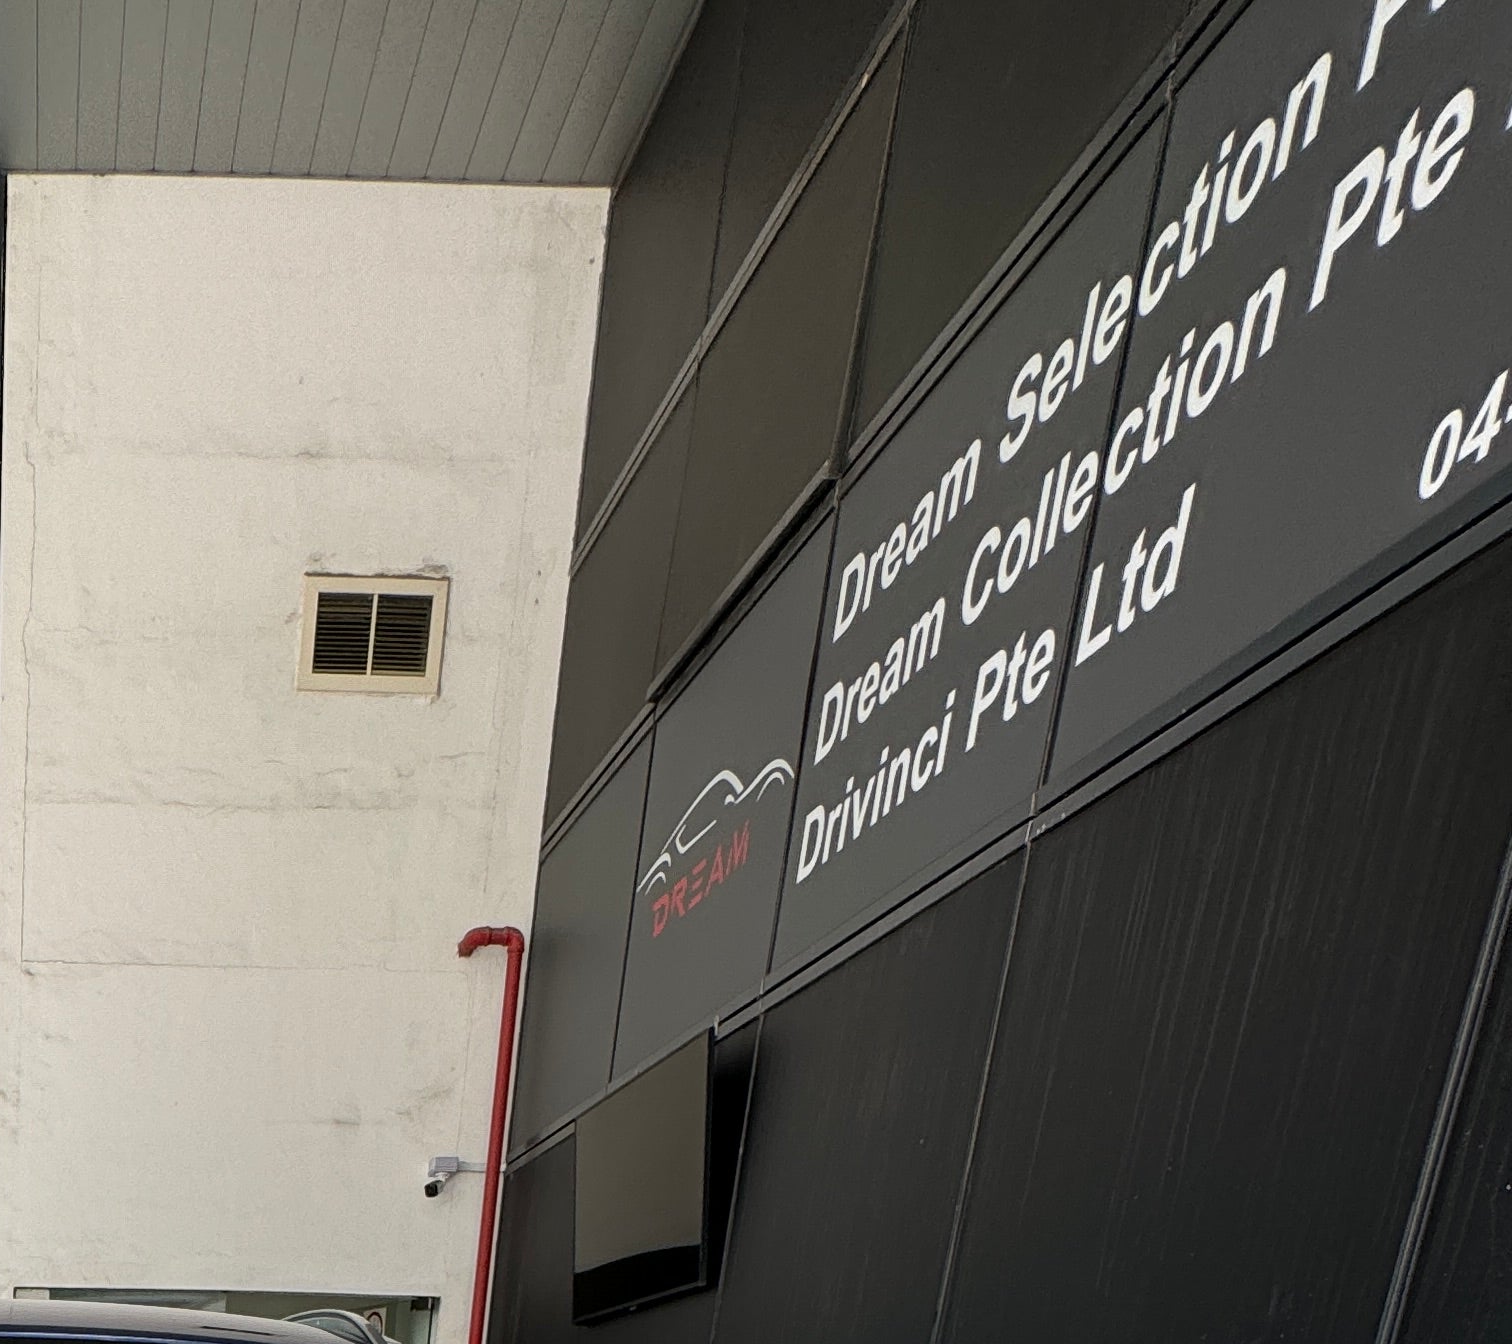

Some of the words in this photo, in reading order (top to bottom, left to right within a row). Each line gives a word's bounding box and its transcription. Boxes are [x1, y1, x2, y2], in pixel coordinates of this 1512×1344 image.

[814, 597, 945, 766] Dream
[962, 267, 1286, 625] Collection
[1308, 87, 1474, 314] Pte
[833, 438, 982, 643] Dream
[999, 52, 1331, 463] Selection
[651, 820, 750, 938] DREAM
[796, 689, 956, 884] Drivinci
[964, 629, 1056, 752] Pte
[1075, 482, 1196, 667] Ltd
